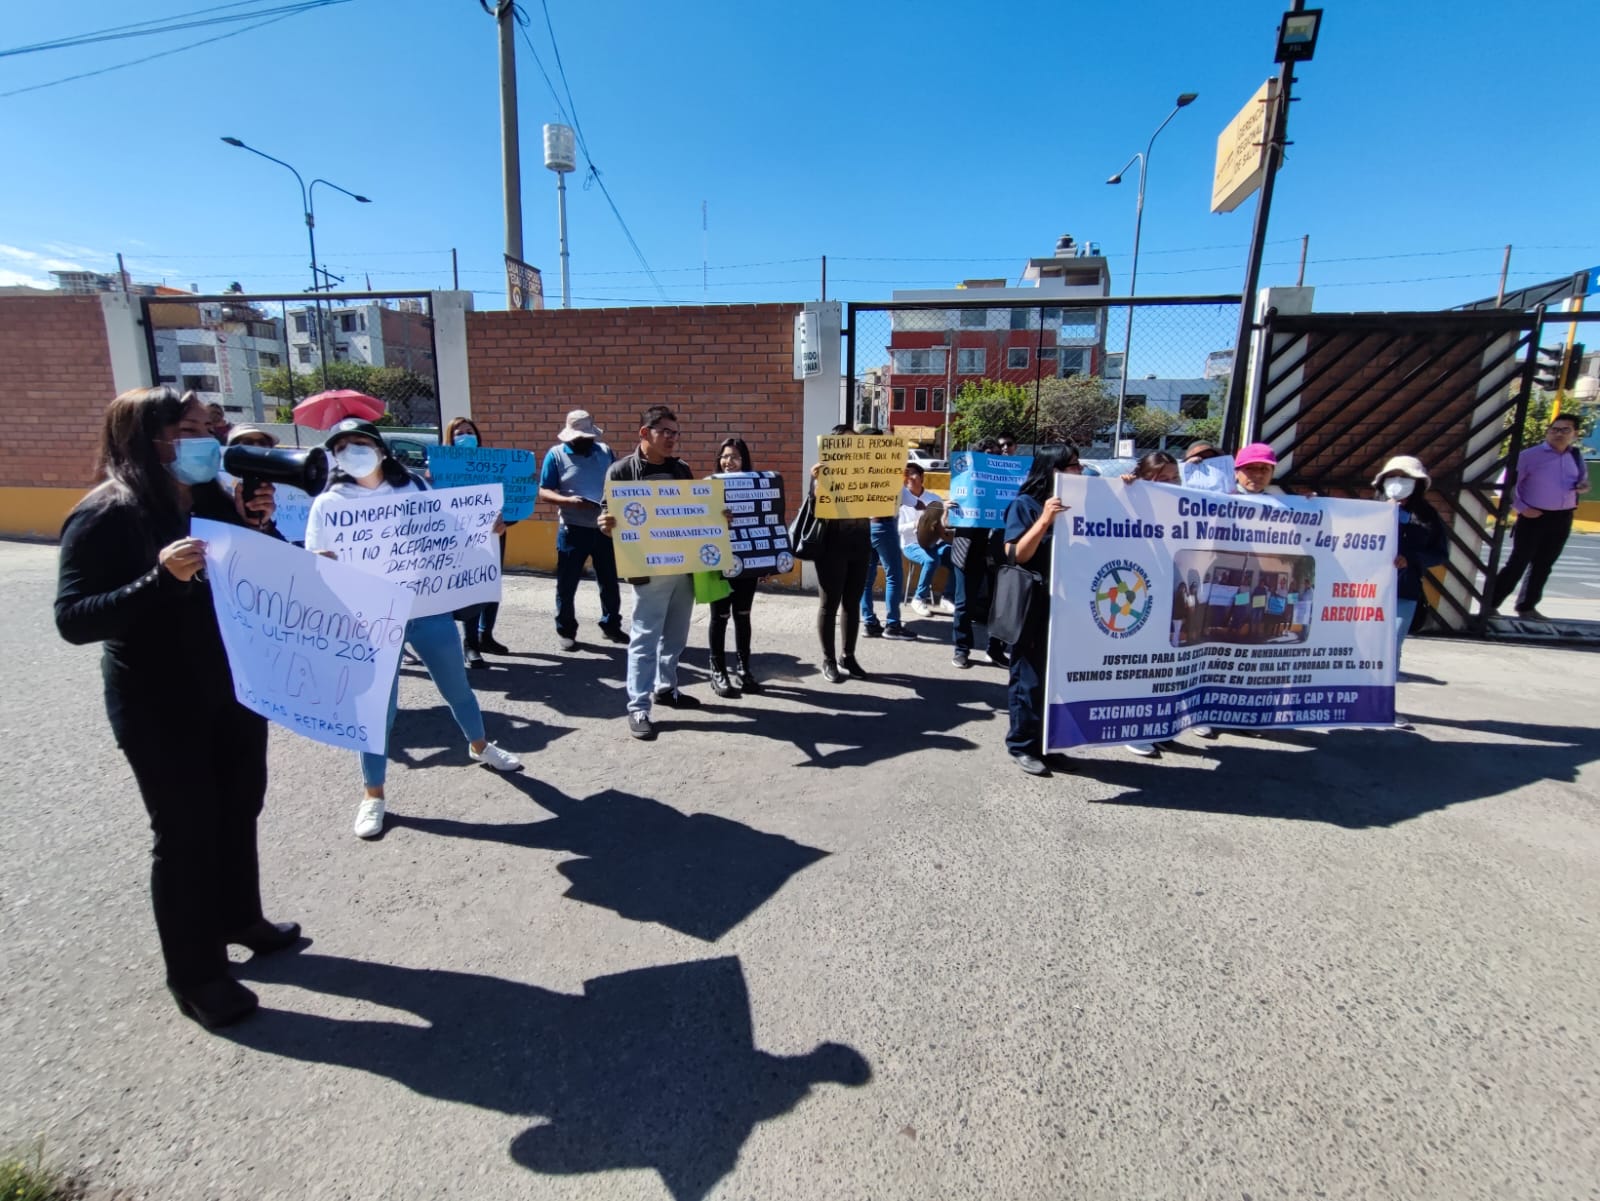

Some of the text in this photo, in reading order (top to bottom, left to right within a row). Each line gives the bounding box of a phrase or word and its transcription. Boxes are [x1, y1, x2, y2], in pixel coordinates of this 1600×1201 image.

[512, 451, 530, 462] LEY
[891, 452, 901, 460] NO
[987, 459, 1021, 468] EXIGIMOS
[465, 461, 508, 473] 30957
[611, 487, 710, 497] JUSTICIA PARA LOS
[848, 481, 858, 490] ES
[450, 493, 493, 508] AHORA
[819, 495, 831, 503] ES
[655, 507, 705, 516] EXCLUIDOS
[1178, 497, 1324, 526] Colectivo Nacional
[334, 532, 344, 543] A
[352, 529, 373, 542] LOS
[621, 532, 640, 540] DEL
[650, 527, 722, 538] NOMBRAMIENTO
[1073, 516, 1165, 539] Excluidos
[1171, 521, 1189, 540] al
[1196, 521, 1302, 546] Nombramiento
[1315, 530, 1340, 552] Ley
[1342, 532, 1387, 551] 30957
[362, 545, 380, 560] NO
[390, 535, 458, 556] ACEPTAMOS
[465, 531, 489, 547] MAS
[646, 556, 661, 565] LEY
[447, 564, 498, 590] DERECHO
[1091, 559, 1152, 592] COLECTIVO NACIONAL
[1332, 578, 1377, 598] REGIÓN
[1321, 606, 1385, 622] AREQUIPA
[262, 623, 329, 650] ULTIMO
[335, 640, 380, 663] 20%
[1110, 631, 1119, 639] AL
[1102, 654, 1148, 666] JUSTICIA
[1151, 653, 1175, 664] PARA
[1177, 651, 1191, 662] LOS
[1234, 648, 1248, 657] DE
[1251, 648, 1311, 658] NOMBRAMIENTO
[1312, 647, 1327, 656] LEY
[1328, 647, 1353, 656] 30957
[1067, 671, 1113, 683] VENIMOS
[1115, 668, 1173, 680] ESPERANDO
[1175, 665, 1190, 676] MAS
[1207, 658, 1234, 670] AÑOS
[1237, 662, 1257, 672] CON
[1259, 661, 1274, 671] UNA
[1277, 661, 1291, 671] LEY
[1292, 661, 1330, 670] APROBADA
[1332, 660, 1344, 669] EN
[1345, 660, 1356, 669] EL
[1152, 680, 1188, 693] NUESTRA
[1199, 674, 1226, 684] VENCE
[1229, 674, 1244, 684] EN
[1247, 675, 1291, 685] DICIEMBRE
[1089, 704, 1153, 721] EXIGIMOS
[1157, 703, 1172, 717] LA
[1203, 691, 1280, 706] APROBACIÓN
[1282, 693, 1301, 705] DEL
[1304, 692, 1324, 704] CAP
[1327, 692, 1335, 703] Y
[1337, 692, 1359, 703] PAP
[294, 713, 368, 742] RETRASOS
[1121, 724, 1139, 738] NO
[1142, 722, 1169, 737] MAS
[1260, 712, 1272, 723] NI
[1274, 709, 1330, 722] RETRASOS
